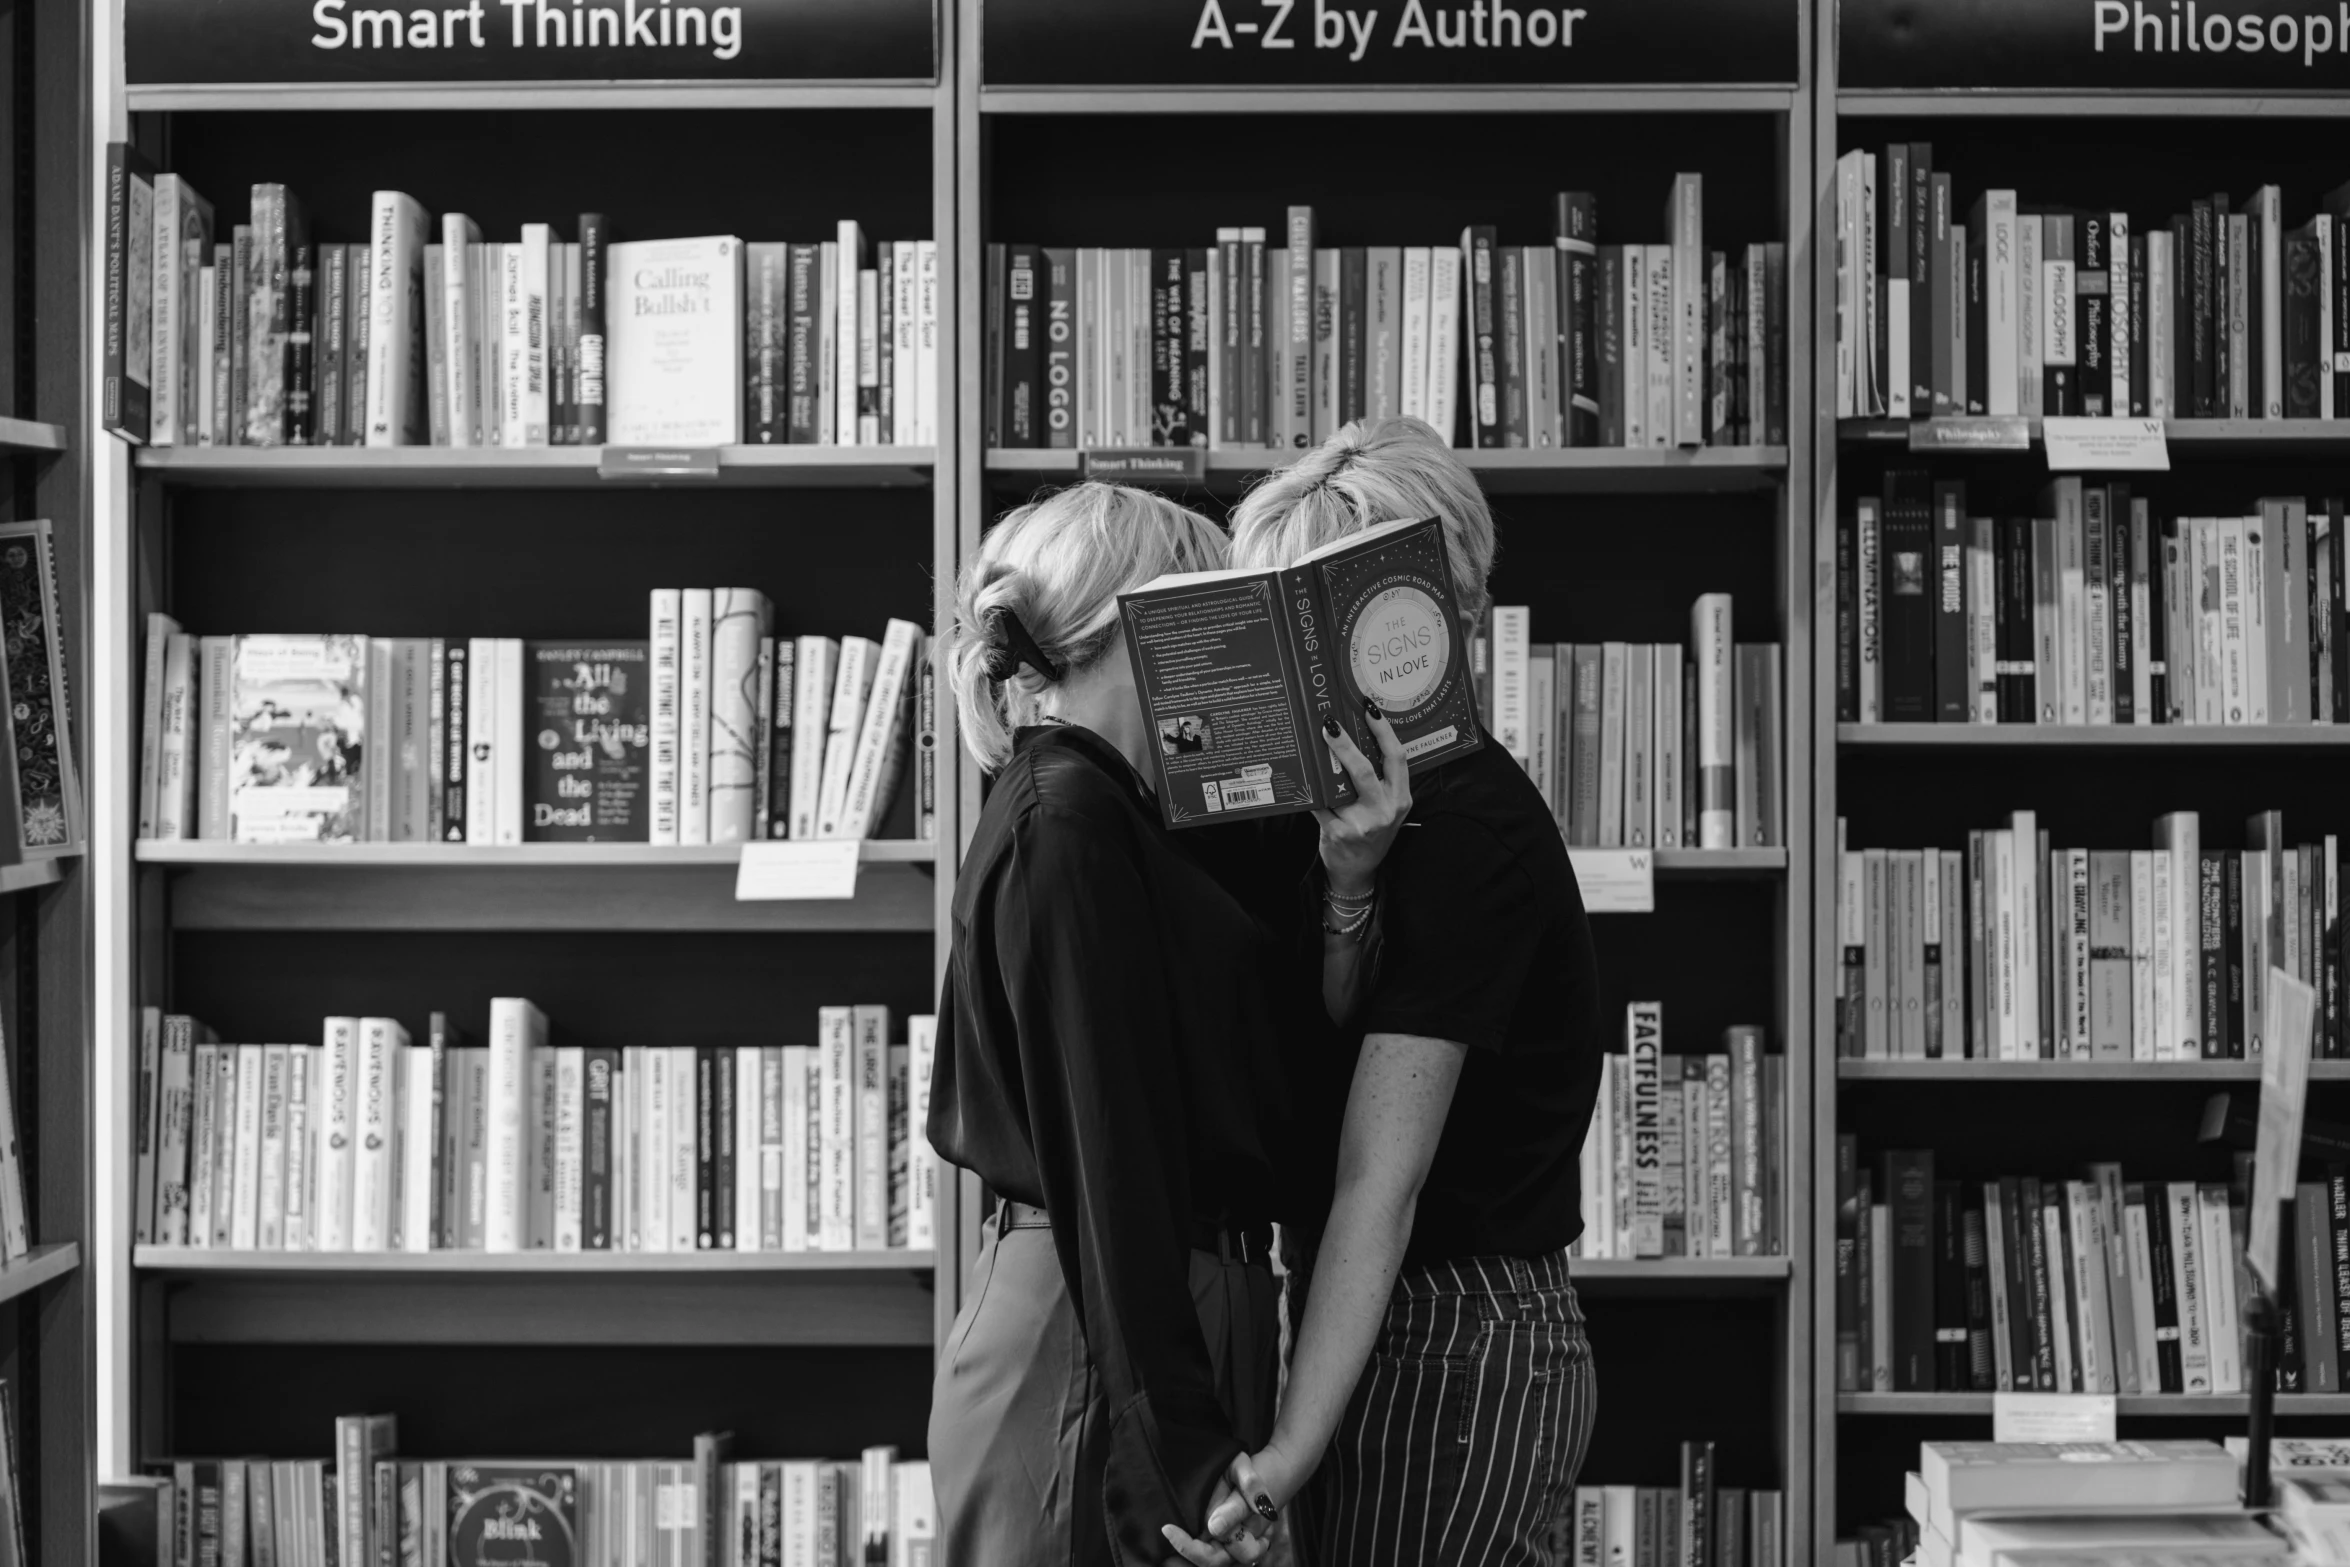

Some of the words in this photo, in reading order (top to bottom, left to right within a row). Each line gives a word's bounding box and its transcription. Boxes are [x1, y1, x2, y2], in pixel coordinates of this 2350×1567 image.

[311, 0, 485, 49] Smart
[508, 0, 742, 60] Thinking
[1191, 0, 1295, 48] A-Z
[1315, 0, 1378, 61] by
[1392, 0, 1587, 47] Author
[110, 165, 122, 202] ADAM
[109, 205, 121, 249] DANT'S
[1291, 216, 1309, 270] CULTURE
[1995, 221, 2010, 265] LOGIC
[2022, 223, 2033, 243] THE
[2086, 220, 2101, 268] Oxford
[156, 224, 170, 268] ATLAS
[376, 205, 394, 290] THINKING
[899, 251, 914, 274] The
[922, 251, 937, 274] The
[2022, 244, 2034, 276] STORY
[108, 252, 120, 318] POLITICAL
[156, 273, 170, 293] OF
[634, 266, 712, 292] Calling
[793, 247, 814, 313] Human
[1168, 258, 1181, 282] THE
[2022, 278, 2034, 292] OF
[156, 298, 170, 325] THE
[213, 254, 232, 353] Mindwandering
[899, 278, 914, 316] Sweet
[922, 278, 937, 316] Sweet
[1154, 287, 1168, 336] JEREMY
[1168, 284, 1181, 313] WEB
[1291, 274, 1309, 344] WARLORDS
[2052, 264, 2068, 359] PHILOSOPHY
[528, 294, 544, 347] PERMISSION
[899, 321, 914, 351] Spot
[922, 321, 937, 351] Spot
[1048, 300, 1070, 343] NO
[1168, 316, 1181, 334] OF
[2023, 294, 2035, 357] PHILOSOPHY
[2086, 298, 2101, 371] Philosophy
[107, 321, 118, 357] MAPS
[793, 316, 814, 393] Frontiers
[1154, 339, 1168, 373] LENT
[156, 330, 170, 404] INVISIBLE
[528, 350, 544, 363] TO
[580, 335, 603, 406] COMPLICIT
[860, 338, 874, 376] Think
[1168, 337, 1181, 401] MEANING
[1294, 354, 1307, 382] TALIA
[528, 366, 544, 395] SPEAK
[1048, 351, 1070, 431] LOGO
[1294, 386, 1307, 418] LAVIN
[1936, 426, 2000, 442] Philosophy
[2144, 421, 2161, 434] W
[1090, 458, 1126, 470] Smart
[1129, 457, 1184, 472] Thinking
[2087, 494, 2102, 520] HOW
[2088, 521, 2102, 536] TO
[2224, 534, 2239, 556] THE
[1941, 544, 1962, 569] THE
[2088, 537, 2103, 566] THINK
[2112, 524, 2129, 588] Conspiring
[1295, 587, 1308, 596] THE
[1863, 519, 1881, 665] ILLUMINATIONS
[1941, 570, 1962, 615] WOODS
[2089, 568, 2103, 591] LIKE
[2224, 557, 2240, 599] SCHOOL
[1146, 614, 1173, 622] DEEPENING
[1188, 606, 1223, 616] RELATIONSHIPS
[1235, 601, 1261, 609] ROMANTIC
[1202, 597, 1237, 606] ASTROLOGICAL
[1341, 622, 1350, 637] AN
[1347, 581, 1382, 622] INTERACTIVE
[1382, 574, 1411, 585] COSMIC
[1412, 575, 1432, 589] ROAD
[1430, 585, 1445, 600] MAP
[2089, 592, 2103, 600] A
[2113, 589, 2129, 610] with
[2225, 600, 2240, 615] OF
[658, 617, 674, 639] ALL
[1141, 621, 1175, 630] CONNECTIONS
[1296, 598, 1319, 652] SIGNS
[1385, 616, 1406, 632] THE
[1980, 614, 1993, 656] Truth
[2089, 601, 2105, 674] PHILOSOPHER
[2113, 612, 2129, 629] the
[2226, 616, 2241, 642] LIFE
[658, 645, 674, 669] THE
[776, 642, 794, 665] BAD
[1367, 625, 1431, 665] SIGNS
[2113, 630, 2130, 672] Enemy
[212, 646, 229, 720] Humankind
[573, 663, 611, 690] All
[1379, 670, 1395, 684] IN
[1396, 654, 1430, 679] LOVE
[572, 691, 611, 716] the
[658, 674, 674, 717] LIVING
[775, 665, 793, 729] SAMARITANS
[1310, 663, 1331, 711] LOVE
[1386, 717, 1404, 725] DING
[1405, 712, 1423, 724] LOVE
[1422, 700, 1438, 715] THAT
[1436, 680, 1452, 701] LASTS
[573, 718, 650, 752] Living
[658, 740, 674, 763] AND
[1420, 731, 1453, 749] FAULKNER
[551, 745, 593, 770] and
[557, 774, 593, 798] the
[658, 769, 674, 791] THE
[534, 801, 592, 826] Dead
[658, 799, 674, 834] DEAD
[831, 1017, 845, 1040] The
[862, 1017, 879, 1045] THE
[831, 1042, 845, 1081] Chaos
[1743, 1034, 1757, 1061] How
[334, 1026, 351, 1126] RAVENOUS
[370, 1026, 387, 1126] RAVENOUS
[588, 1059, 610, 1103] GRIT
[862, 1048, 879, 1091] URGE
[1743, 1062, 1758, 1076] To
[1634, 1012, 1660, 1170] FACTFULNESS
[1744, 1076, 1758, 1101] Live
[831, 1083, 845, 1137] Machine
[862, 1093, 879, 1135] CARL
[1708, 1062, 1729, 1167] CONTROL
[1744, 1101, 1758, 1127] With
[862, 1137, 879, 1169] ERIK
[1662, 1090, 1684, 1213] FACTFULNESS
[1744, 1127, 1759, 1155] Each
[671, 1141, 695, 1191] Range
[831, 1147, 845, 1176] Max
[1745, 1155, 1759, 1189] Other
[831, 1178, 845, 1219] Fisher
[862, 1173, 879, 1227] FISHER
[484, 1518, 543, 1540] Blink
[1581, 1501, 1600, 1565] ALCHEMY
